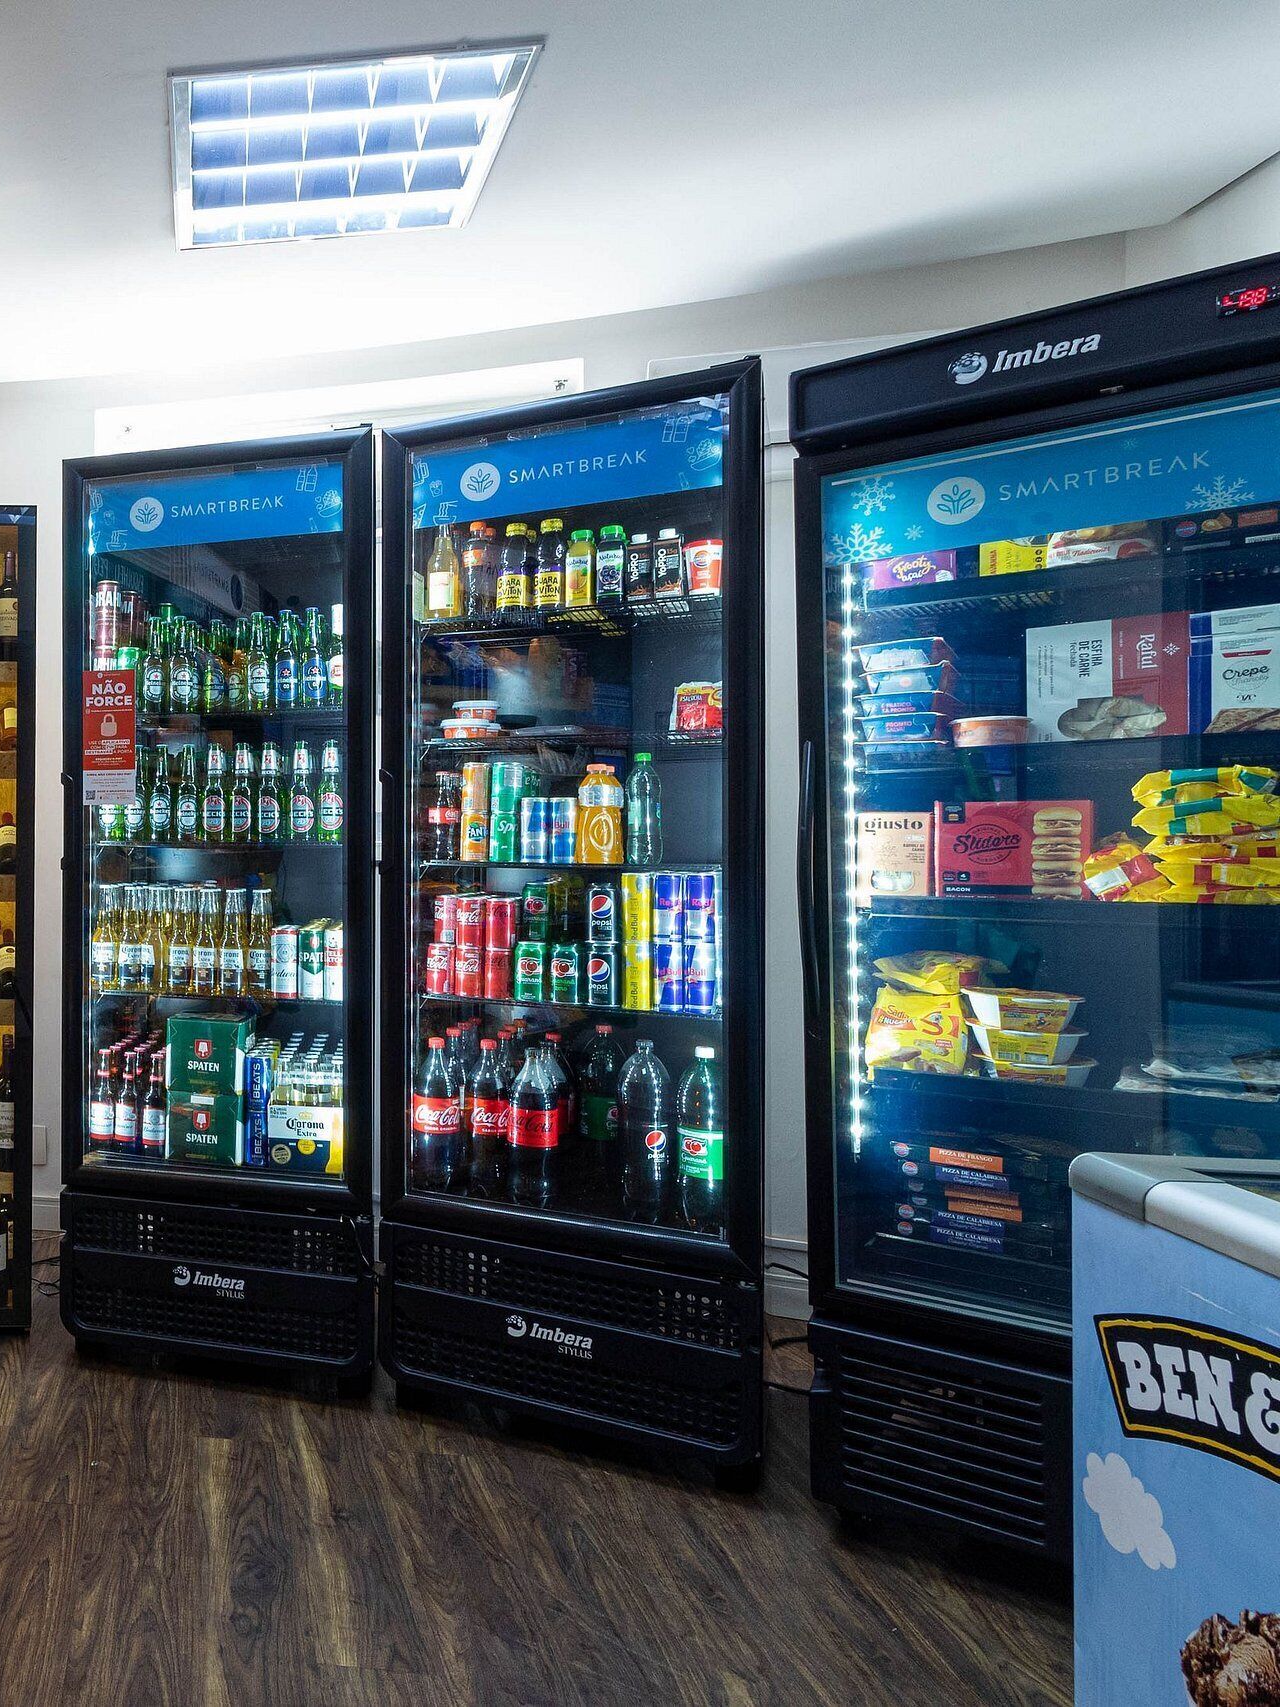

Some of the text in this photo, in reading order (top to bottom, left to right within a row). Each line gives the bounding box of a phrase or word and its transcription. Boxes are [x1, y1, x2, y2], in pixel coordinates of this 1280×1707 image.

[992, 333, 1101, 374] Imbera
[509, 449, 648, 484] SMARTBREAK
[999, 450, 1209, 502] SMARTBREAK
[171, 495, 284, 518] SMARTBREAK
[1091, 639, 1102, 667] ESFIHA
[1136, 634, 1159, 670] Raful
[1078, 653, 1090, 678] CARNE
[1222, 665, 1270, 681] Crepe
[91, 679, 127, 695] NÃO
[85, 695, 133, 707] FORCE
[864, 818, 923, 836] giusto
[591, 919, 612, 927] pepsi
[172, 948, 190, 956] orona
[195, 949, 213, 957] oron
[588, 983, 608, 991] pepsi
[187, 1061, 219, 1072] SPATEN
[286, 1117, 324, 1131] Corona
[185, 1133, 218, 1144] SPATEN
[254, 1118, 262, 1154] BEATS
[296, 1129, 317, 1137] Extra
[938, 1149, 956, 1157] PIZZA
[966, 1154, 993, 1163] FRANGO
[942, 1167, 960, 1175] PIZZA
[970, 1172, 1007, 1182] CALABRESA
[938, 1211, 956, 1219] PIZZA
[966, 1216, 1002, 1227] CALABRESA
[936, 1228, 954, 1236] PIZZA
[964, 1233, 1001, 1244] CALABRESA
[192, 1271, 245, 1291] Imbera
[216, 1289, 245, 1299] STYLUS
[529, 1323, 592, 1349] Imbera
[558, 1345, 592, 1359] STYLUS
[1116, 1341, 1242, 1436] BEN
